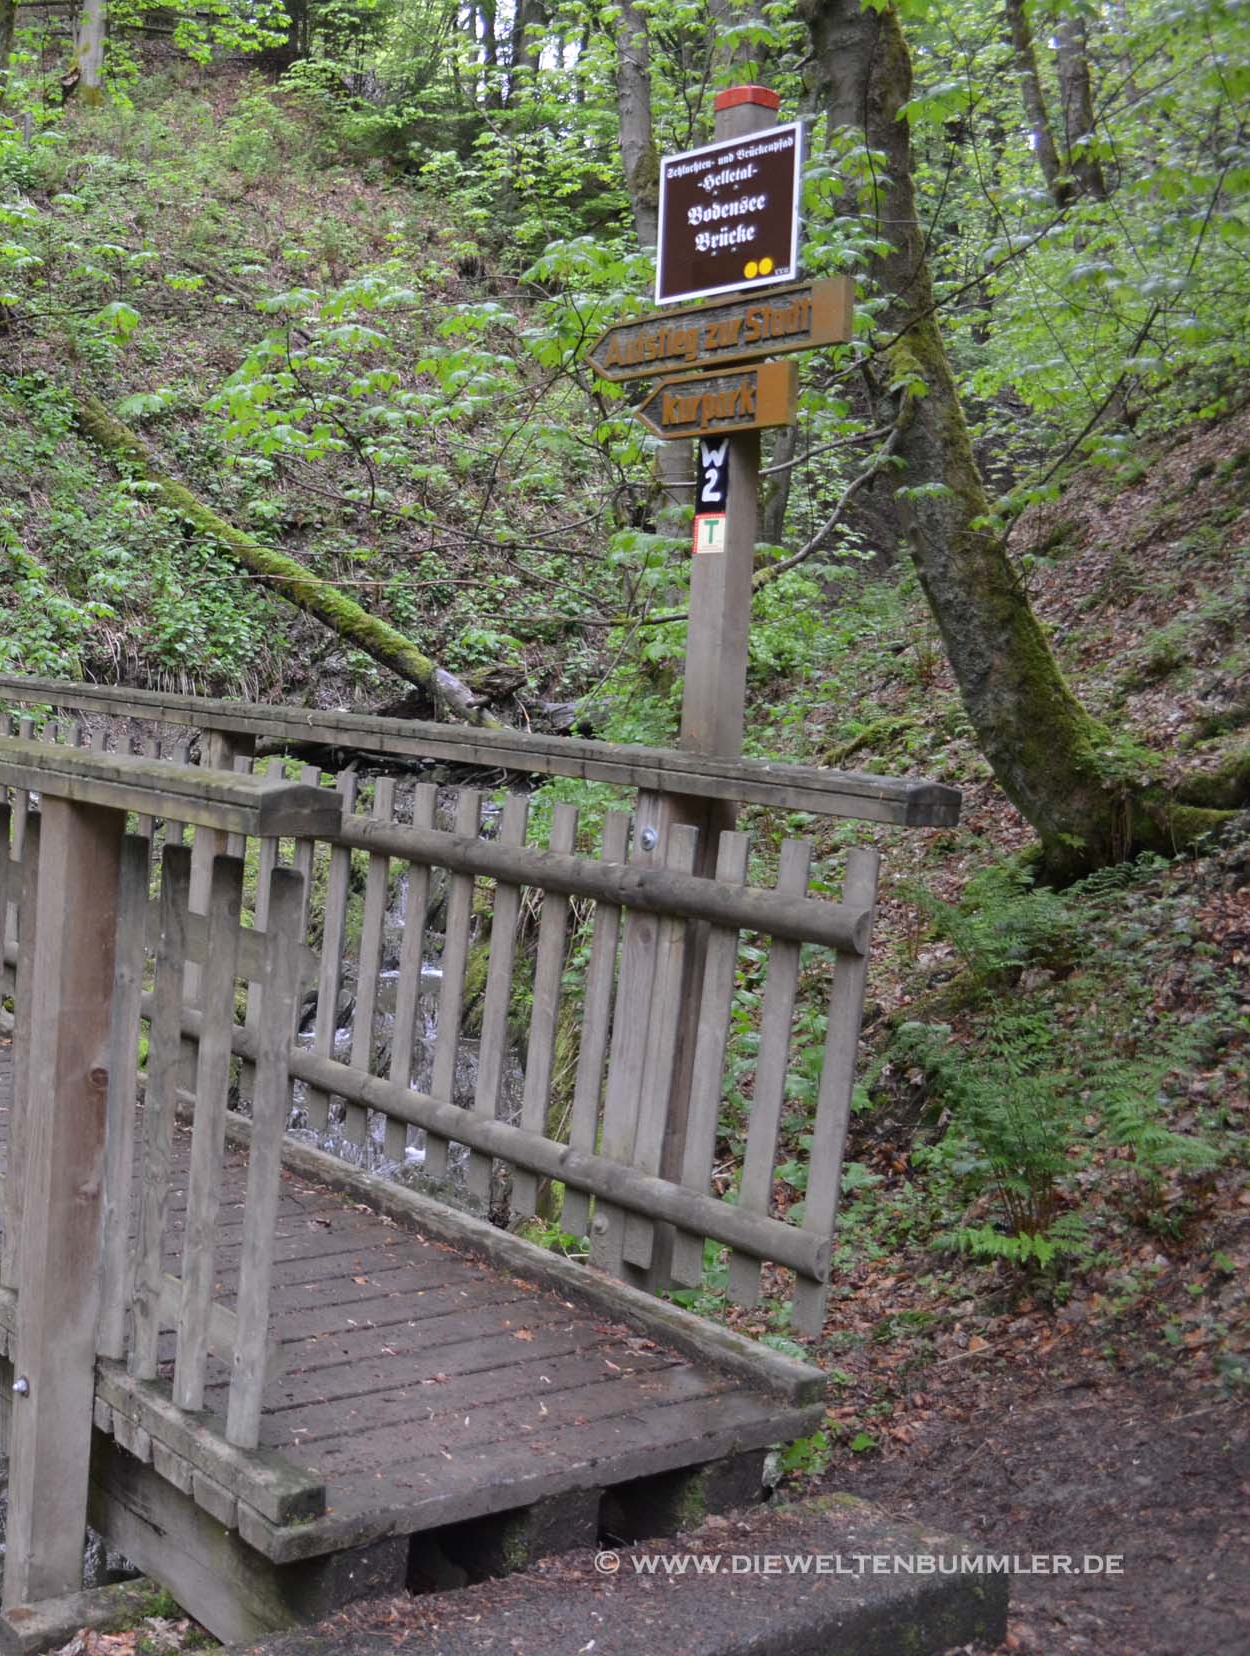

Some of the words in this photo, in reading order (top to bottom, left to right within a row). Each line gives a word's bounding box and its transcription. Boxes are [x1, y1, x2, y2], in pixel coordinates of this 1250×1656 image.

[718, 152, 735, 165] und
[687, 194, 766, 225] Bodensee
[695, 223, 756, 252] Brücke
[605, 325, 699, 369] Aufstieg
[704, 318, 744, 350] zur
[744, 297, 813, 342] Stadt
[701, 468, 721, 502] 2
[704, 519, 719, 544] T
